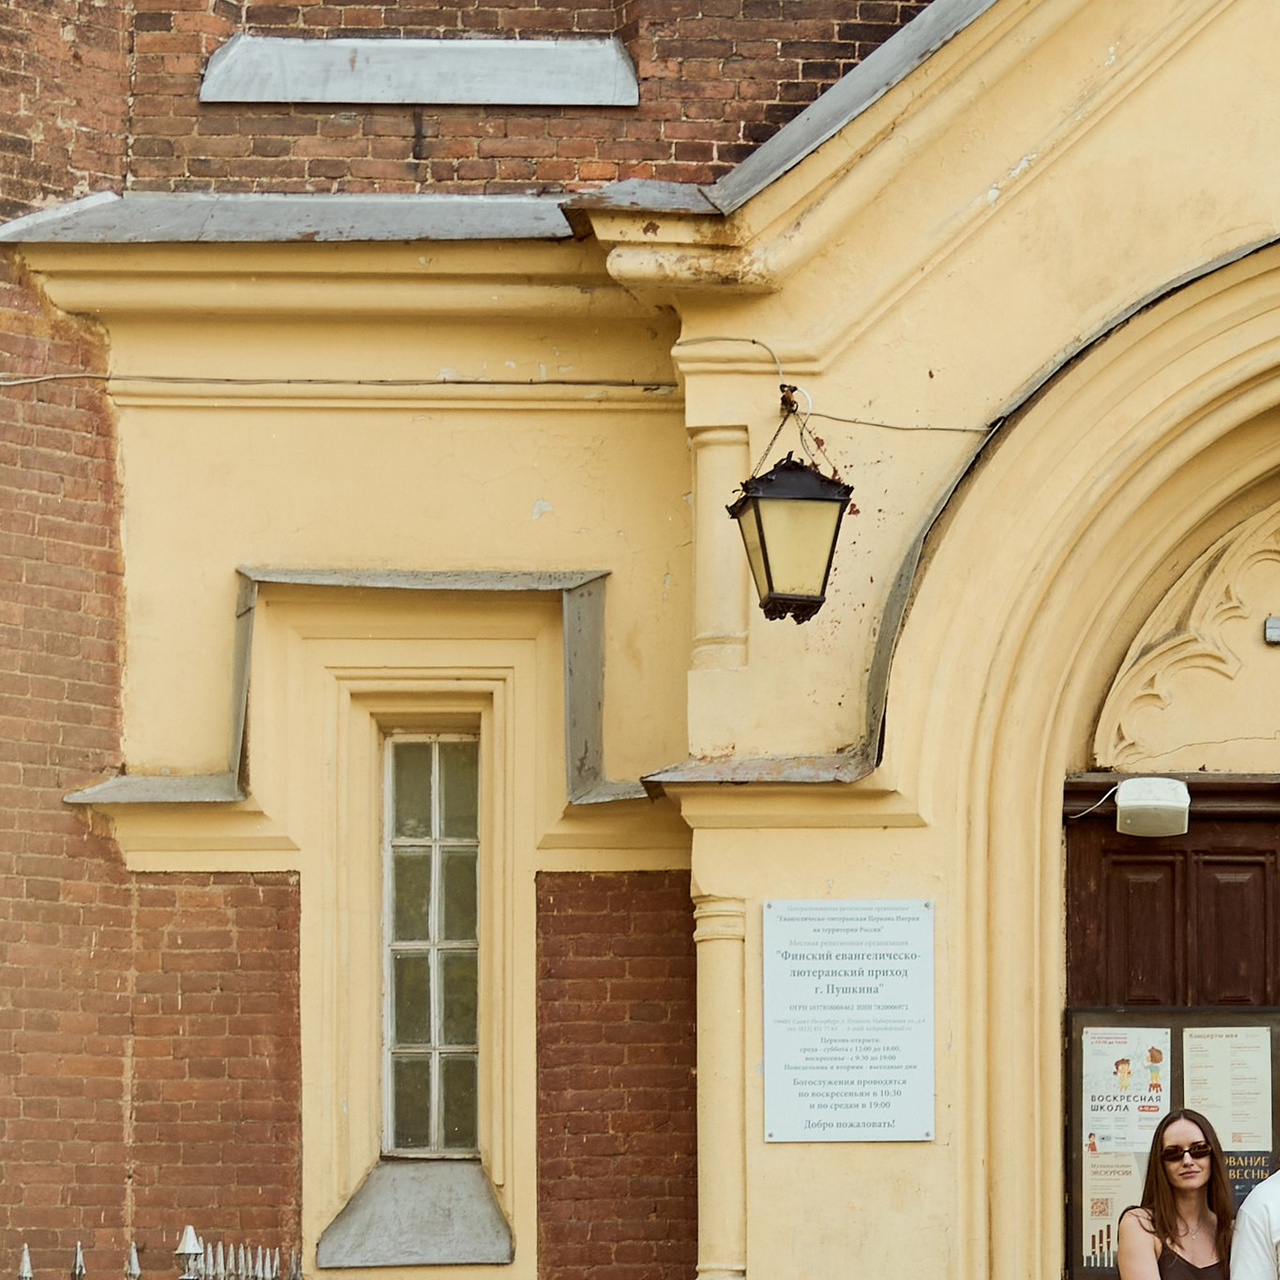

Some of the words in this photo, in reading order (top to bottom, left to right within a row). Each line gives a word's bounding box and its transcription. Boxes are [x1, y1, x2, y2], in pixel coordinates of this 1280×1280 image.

[776, 950, 832, 961] "Финский
[836, 951, 920, 961] евангелическо-
[790, 968, 864, 978] лютеранский
[868, 968, 908, 978] приход
[815, 986, 822, 994] г.
[826, 983, 883, 997] Пушкина"
[793, 1078, 854, 1087] Богослужения
[857, 1078, 907, 1087] проводятся
[811, 1090, 870, 1099] воскресеньям
[804, 1120, 834, 1130] Добро
[836, 1120, 895, 1129] пожаловать!
[1229, 1169, 1269, 1179] ВЕСНЫ
